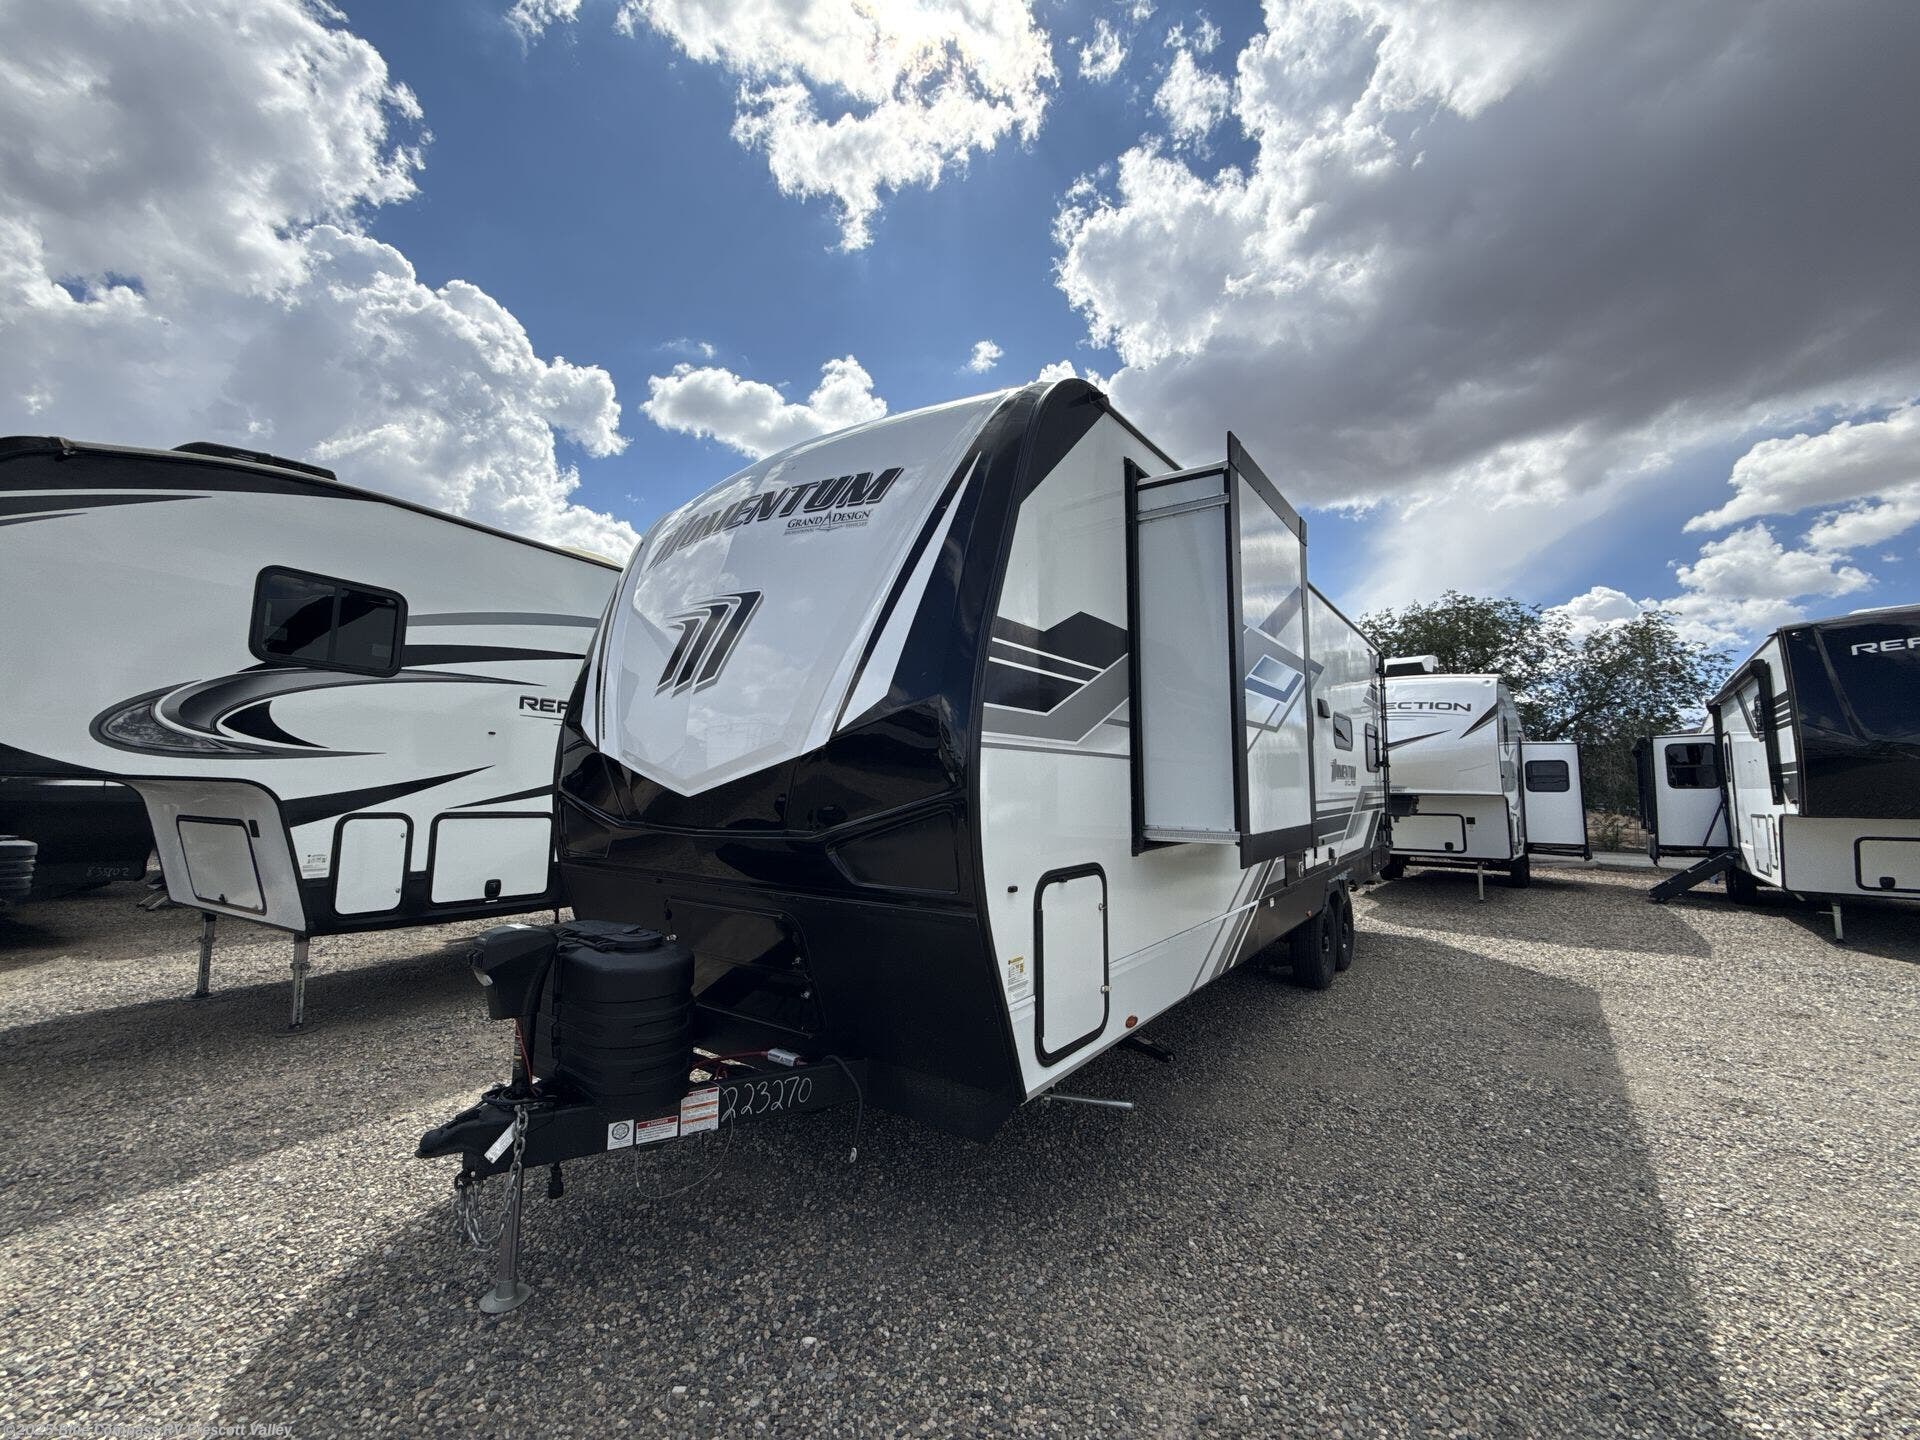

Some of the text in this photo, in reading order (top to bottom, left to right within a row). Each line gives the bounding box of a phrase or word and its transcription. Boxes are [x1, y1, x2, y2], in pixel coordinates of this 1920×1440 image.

[787, 510, 871, 528] GRAND DESIGN
[721, 1076, 812, 1122] 223270
